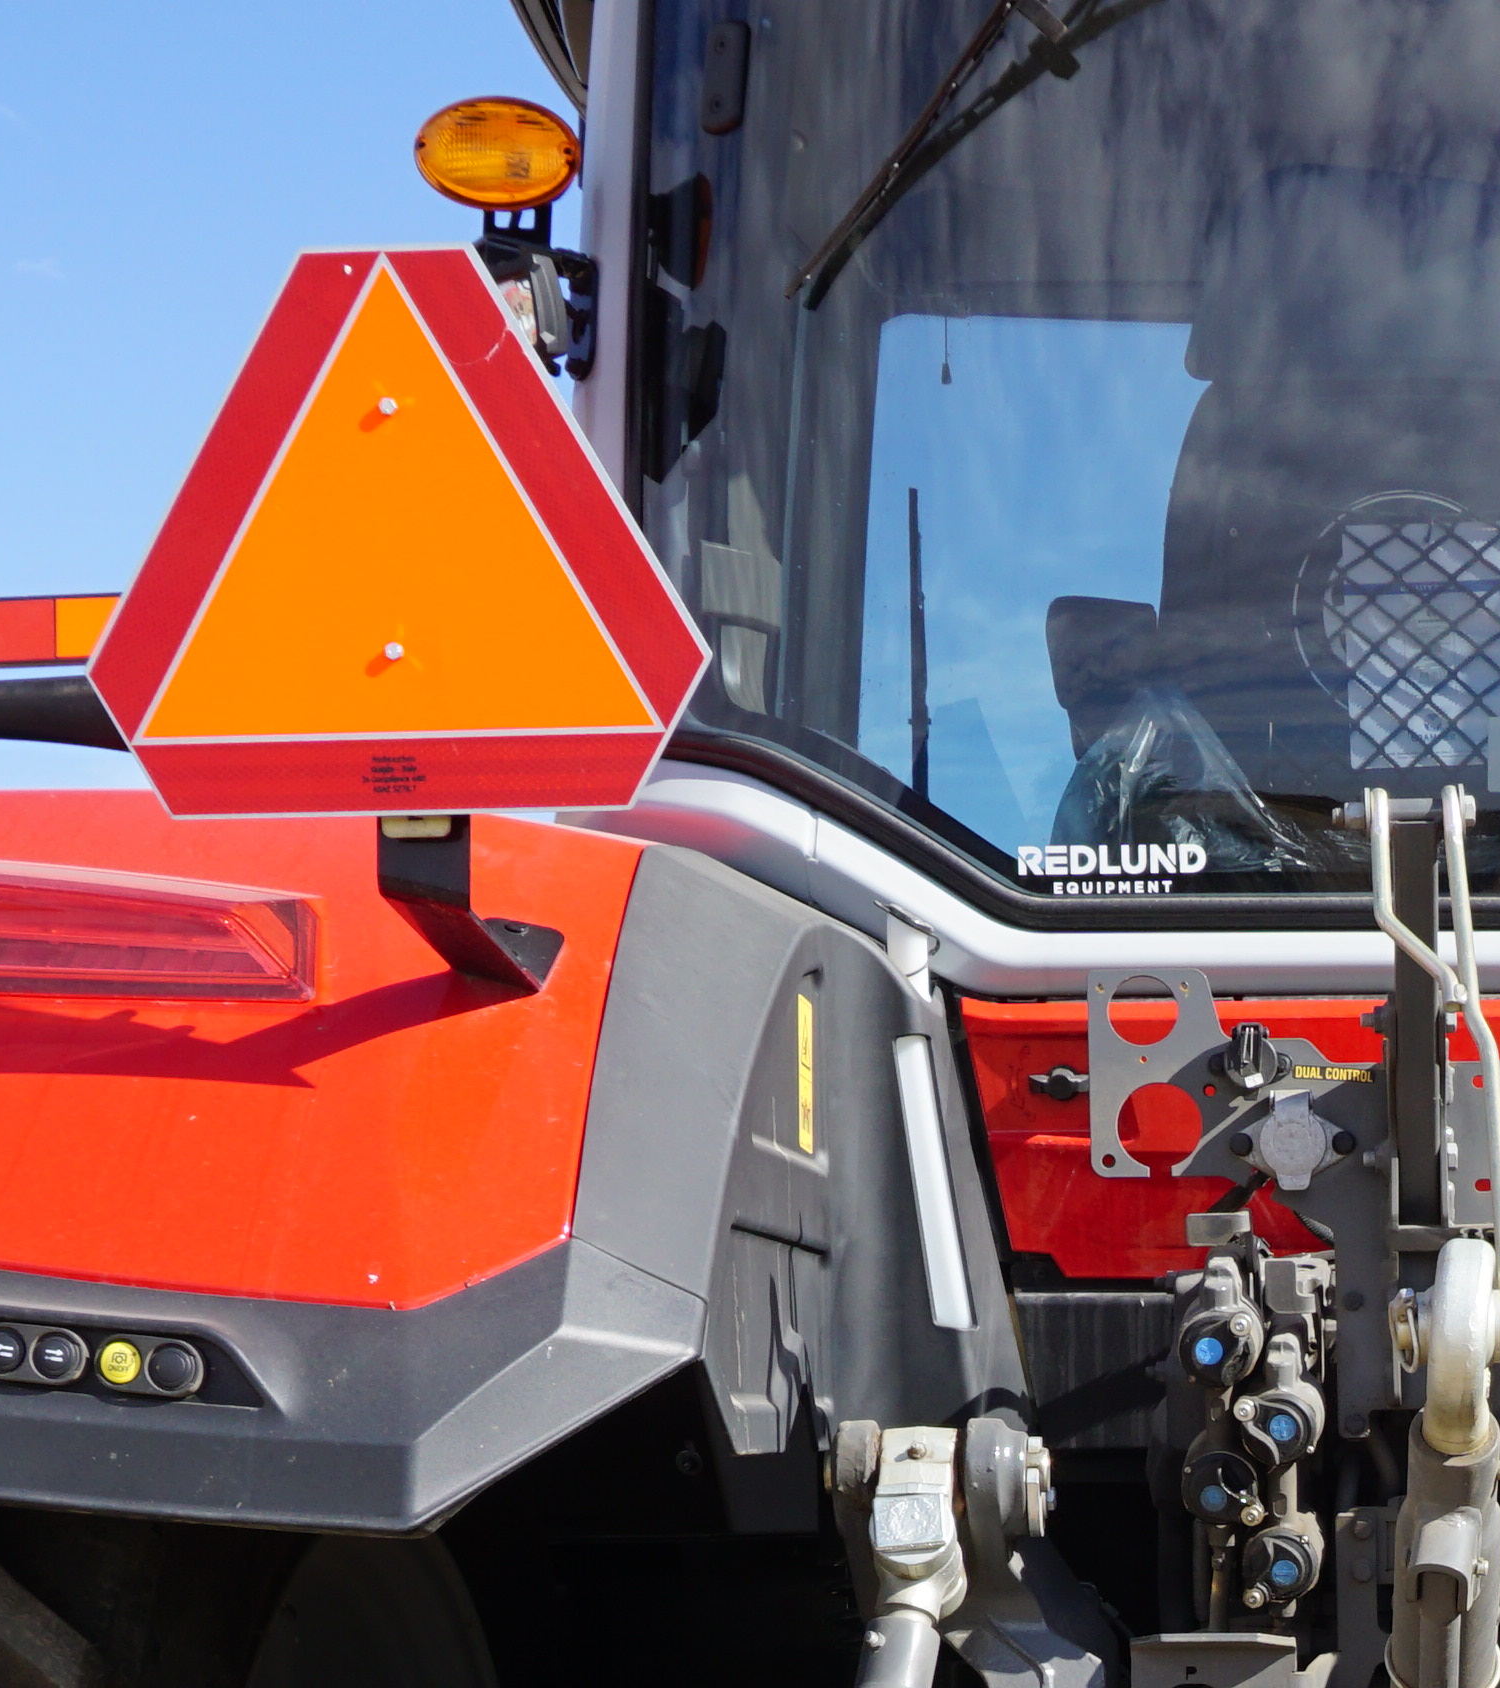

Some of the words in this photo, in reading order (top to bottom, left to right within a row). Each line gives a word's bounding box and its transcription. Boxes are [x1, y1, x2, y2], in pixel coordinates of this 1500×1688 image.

[1017, 843, 1207, 876] REDLUND
[1052, 880, 1173, 895] EQUIPMENT
[1295, 1065, 1323, 1080] DUAL
[1325, 1067, 1373, 1083] CONTROL
[1186, 1666, 1197, 1681] P
